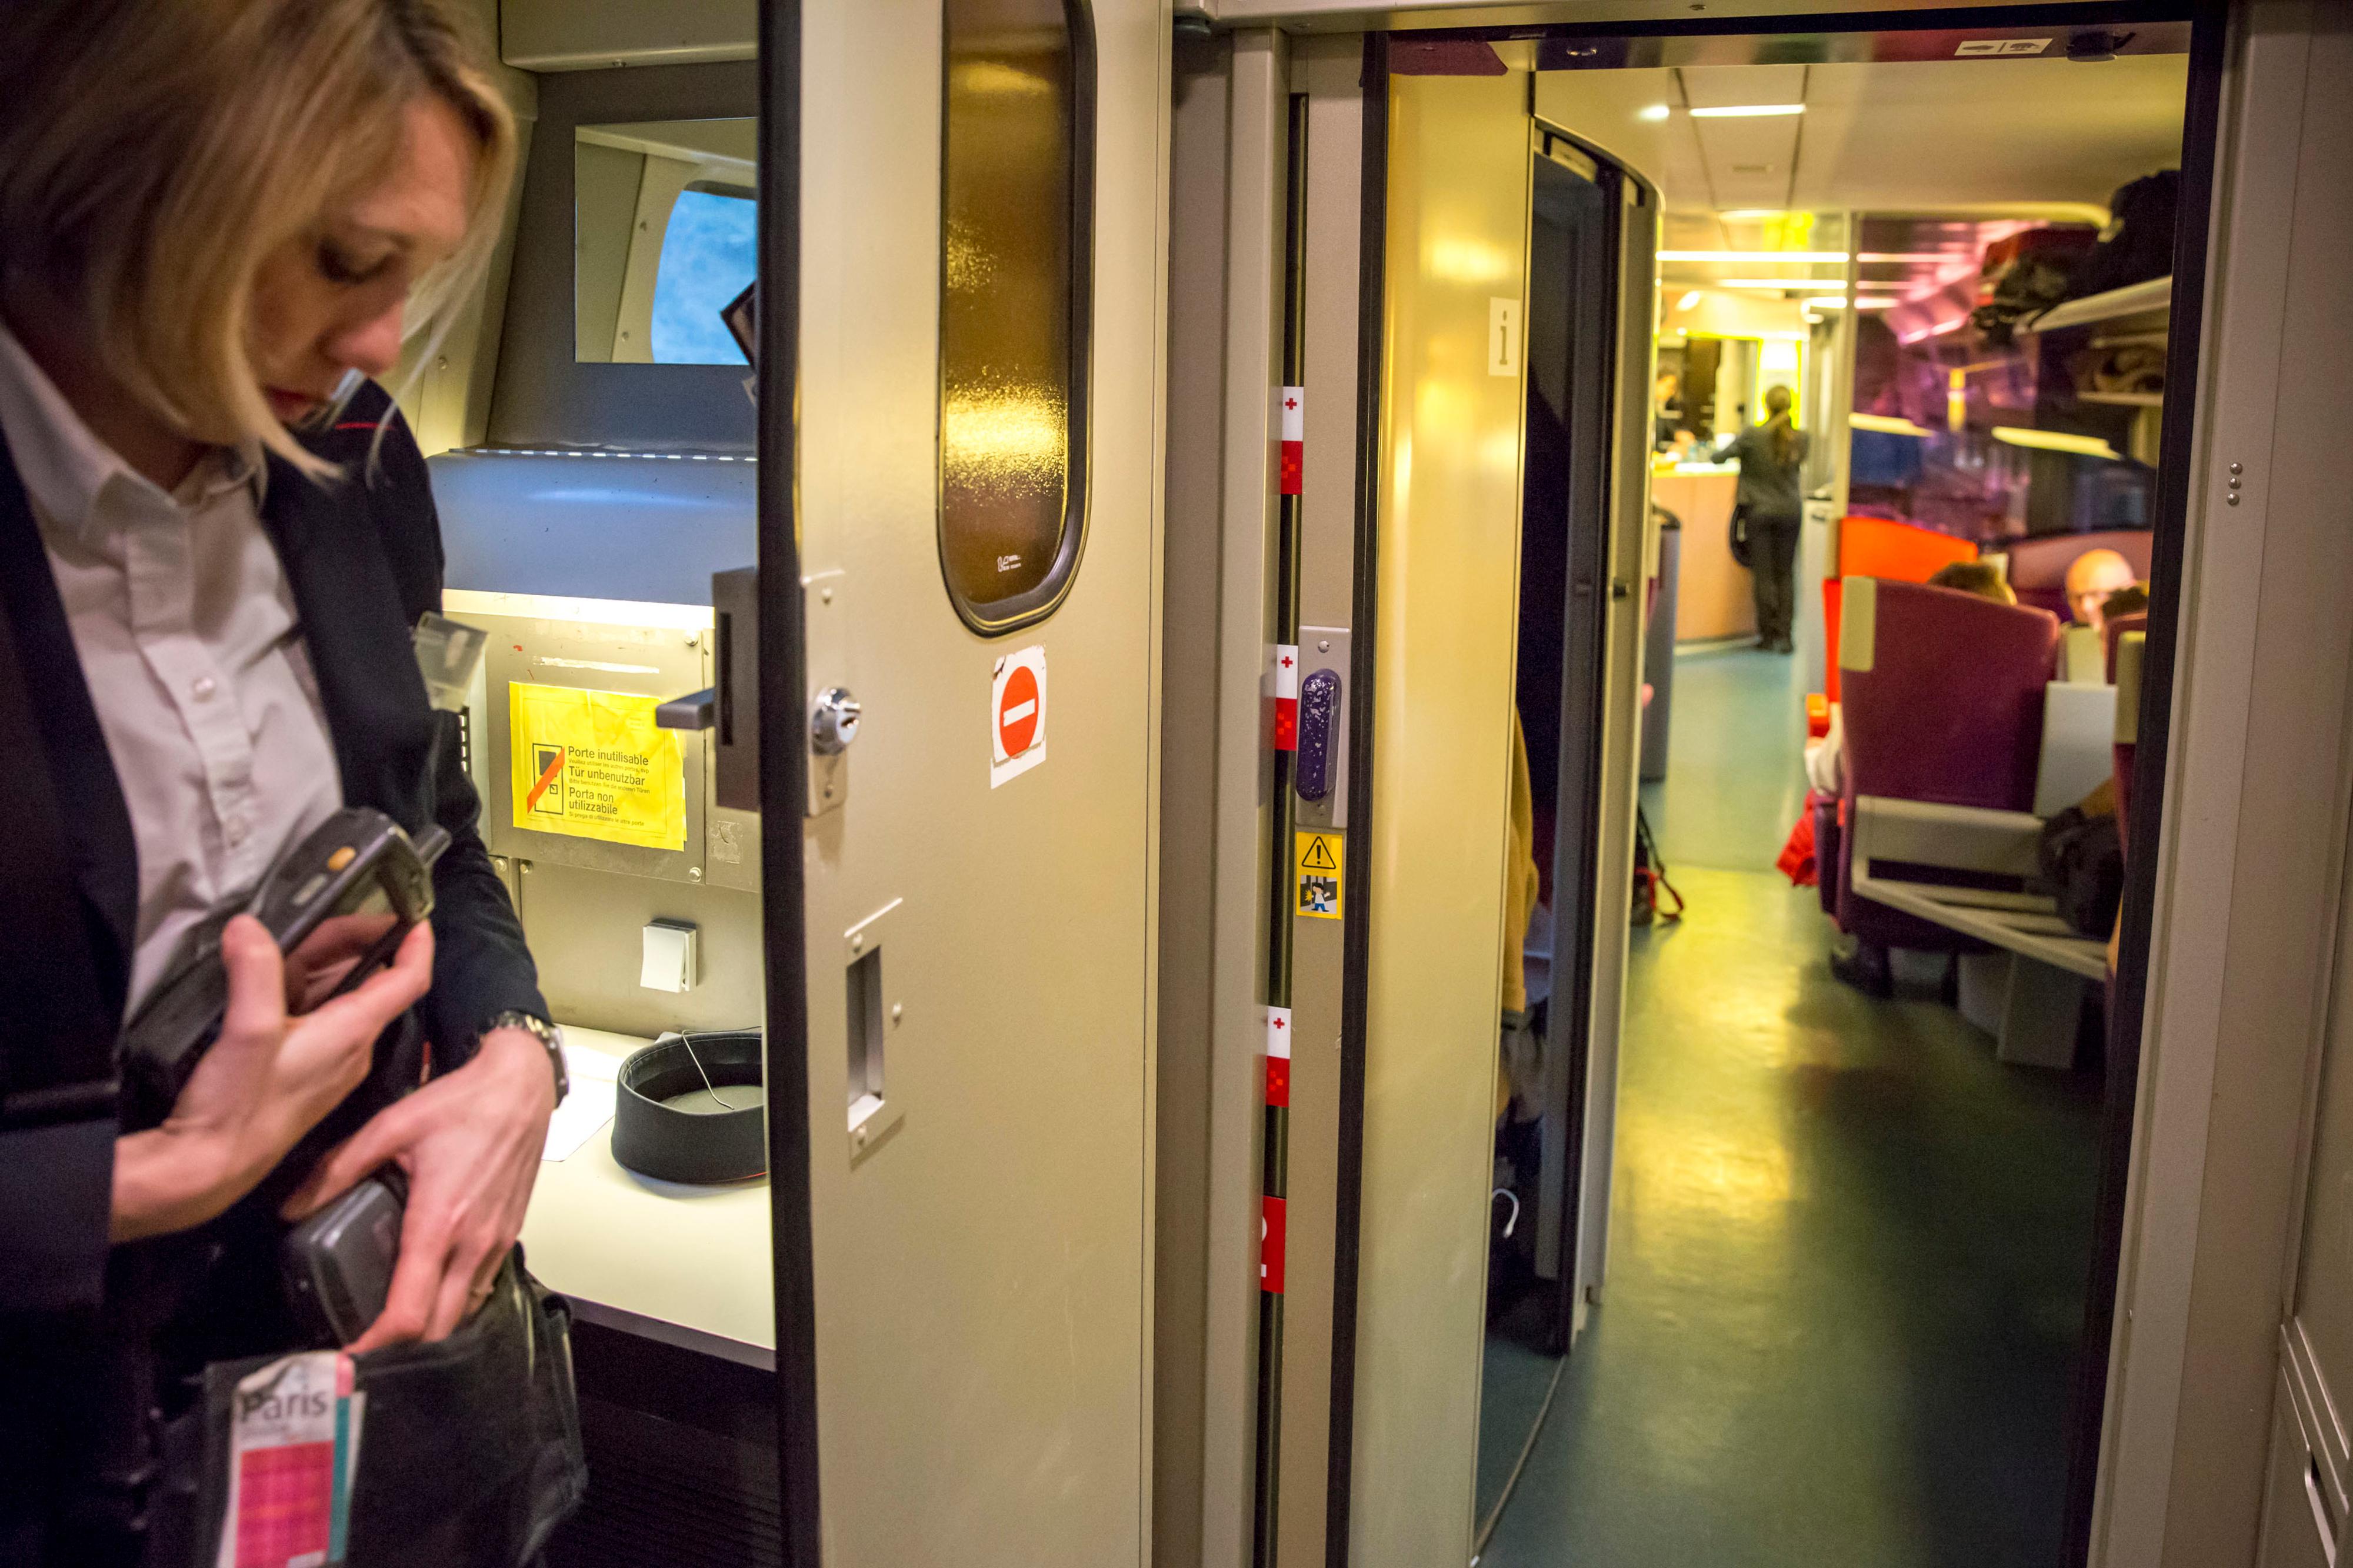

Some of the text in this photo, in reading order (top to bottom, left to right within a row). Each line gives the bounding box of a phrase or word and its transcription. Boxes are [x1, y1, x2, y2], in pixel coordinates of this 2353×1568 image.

[568, 745, 649, 766] Porte inutilisable
[568, 766, 645, 786] Tür unbenutzbar
[569, 786, 614, 803] Porta non
[569, 800, 618, 815] utilizzabile
[240, 1385, 328, 1422] Paris
